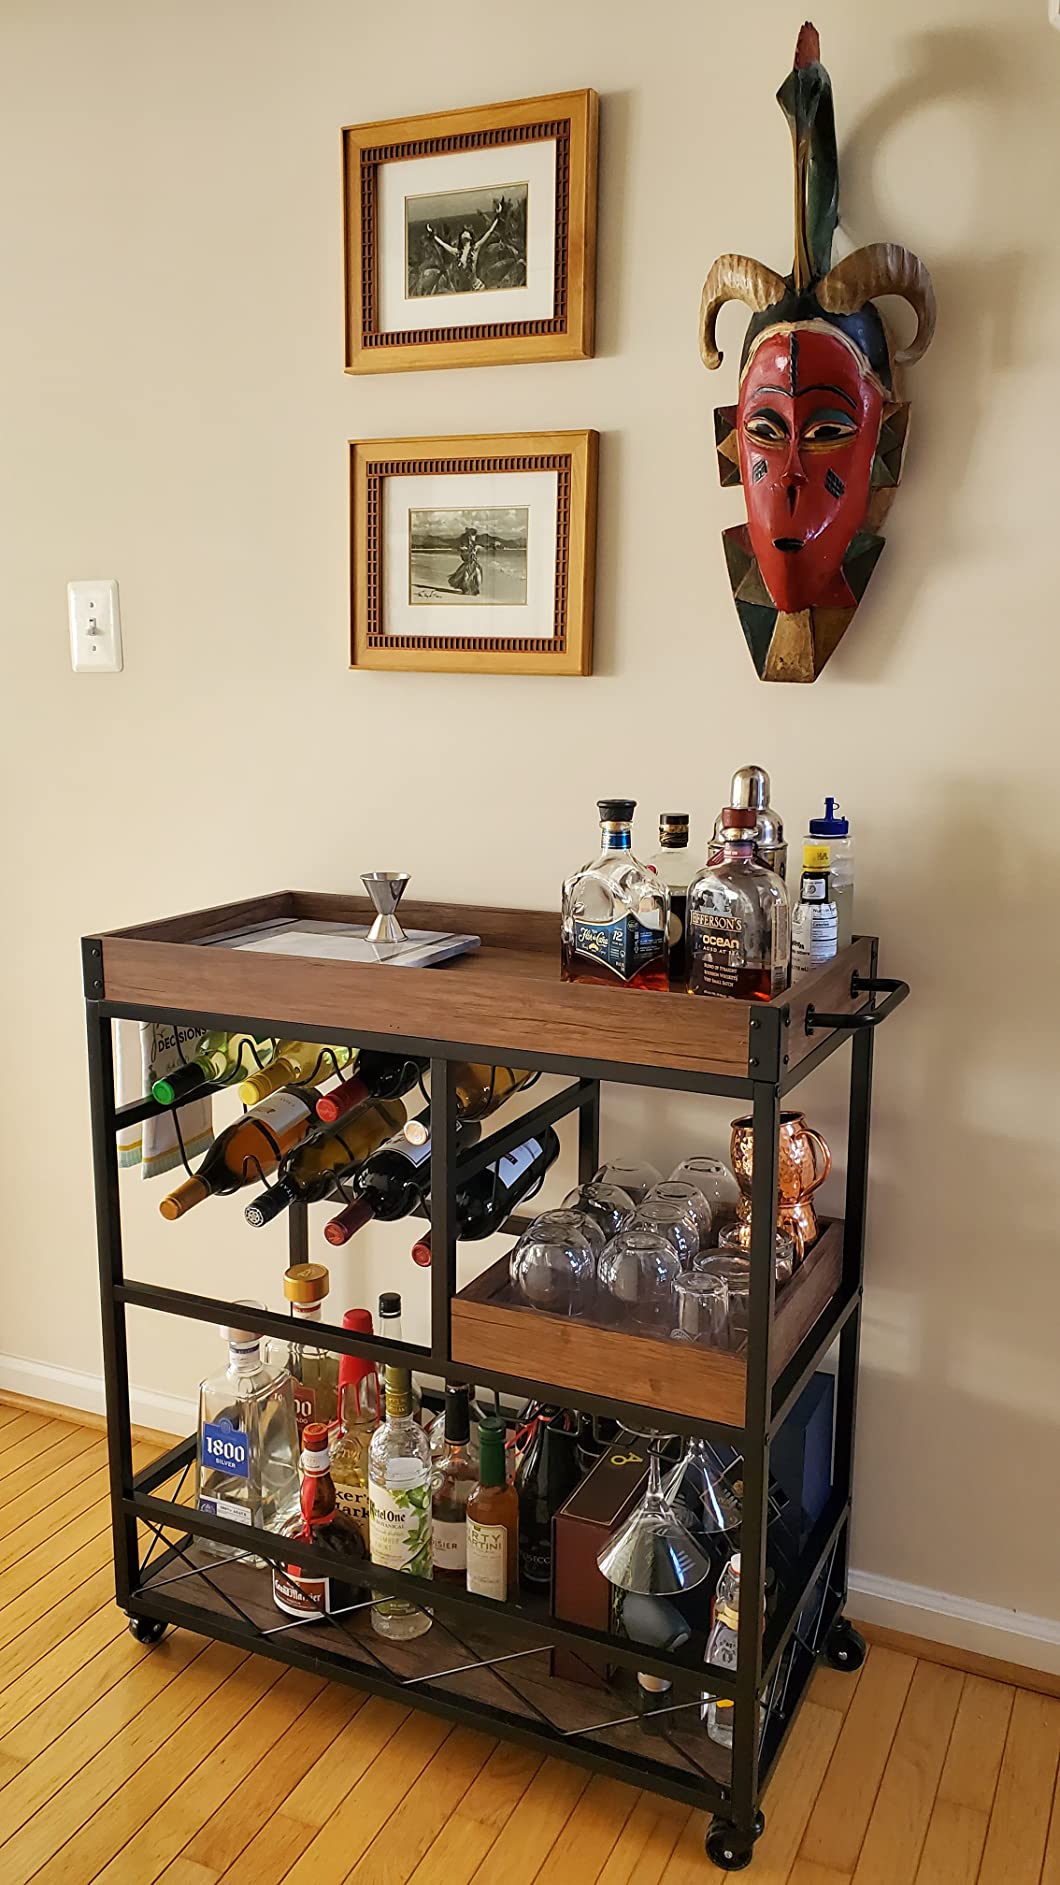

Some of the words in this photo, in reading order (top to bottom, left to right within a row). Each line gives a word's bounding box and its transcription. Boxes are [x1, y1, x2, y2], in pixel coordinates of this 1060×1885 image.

[612, 930, 623, 941] 12
[158, 1027, 207, 1053] DECSIONS
[206, 1437, 245, 1462] 1800
[215, 1458, 236, 1469] SILVER
[335, 1502, 370, 1519] ark
[386, 1510, 406, 1522] One
[470, 1530, 501, 1543] RTY
